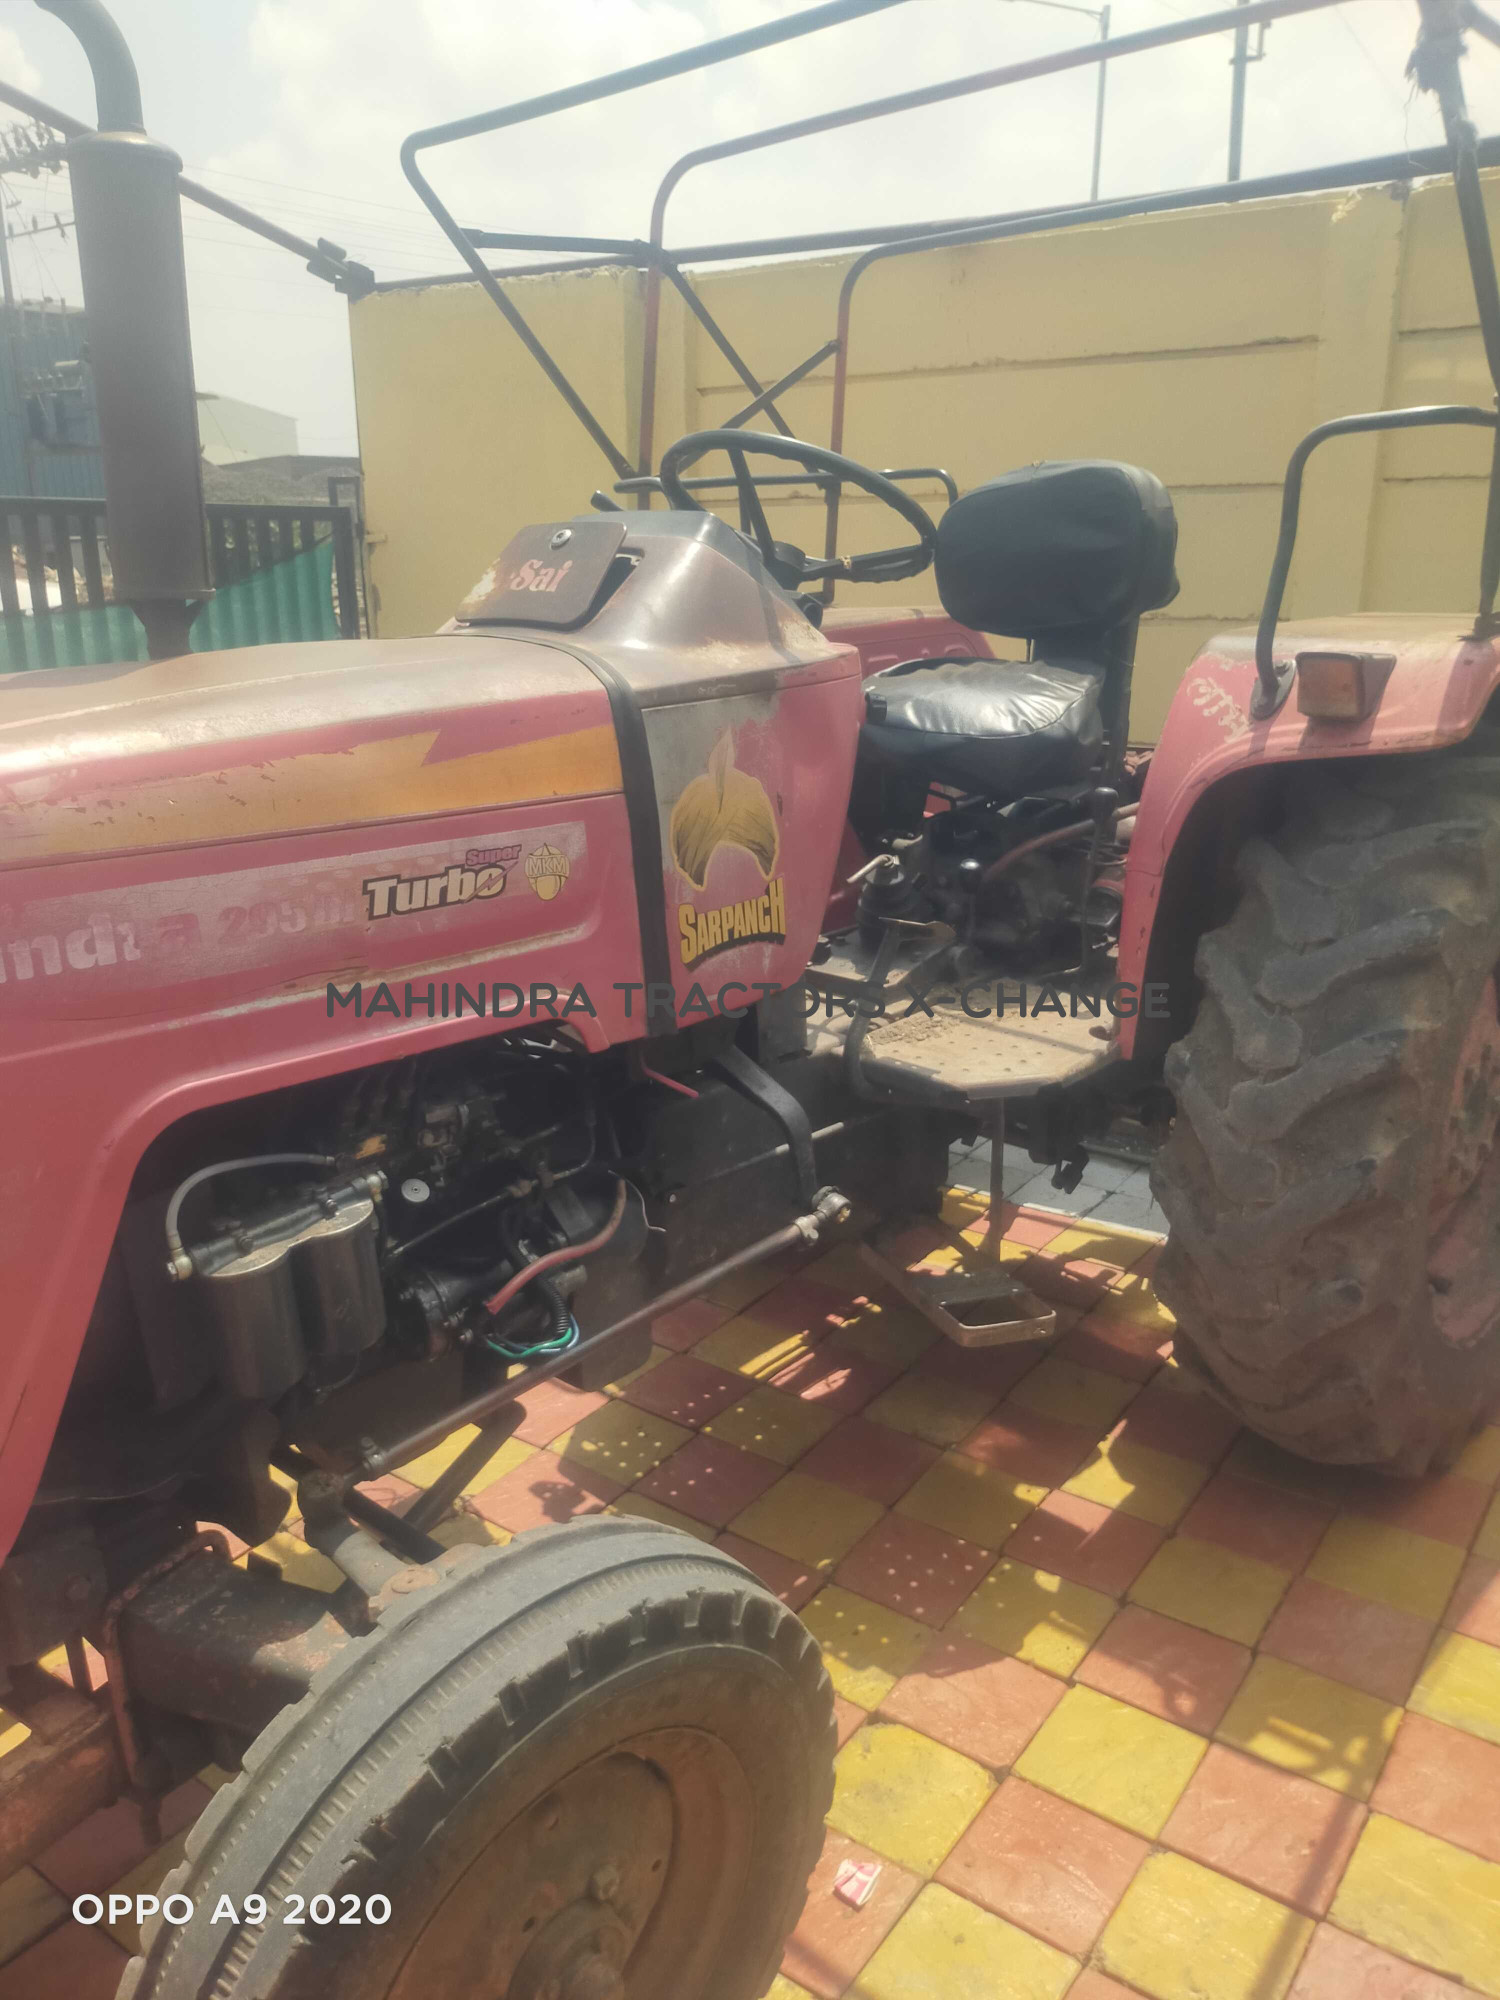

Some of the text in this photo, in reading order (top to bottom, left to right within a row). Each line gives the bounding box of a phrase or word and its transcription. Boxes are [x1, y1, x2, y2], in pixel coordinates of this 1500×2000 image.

[509, 558, 574, 593] Sai
[465, 844, 522, 867] Super
[528, 855, 568, 877] MKM
[362, 861, 508, 921] Turbo
[677, 875, 788, 966] SARPANCH
